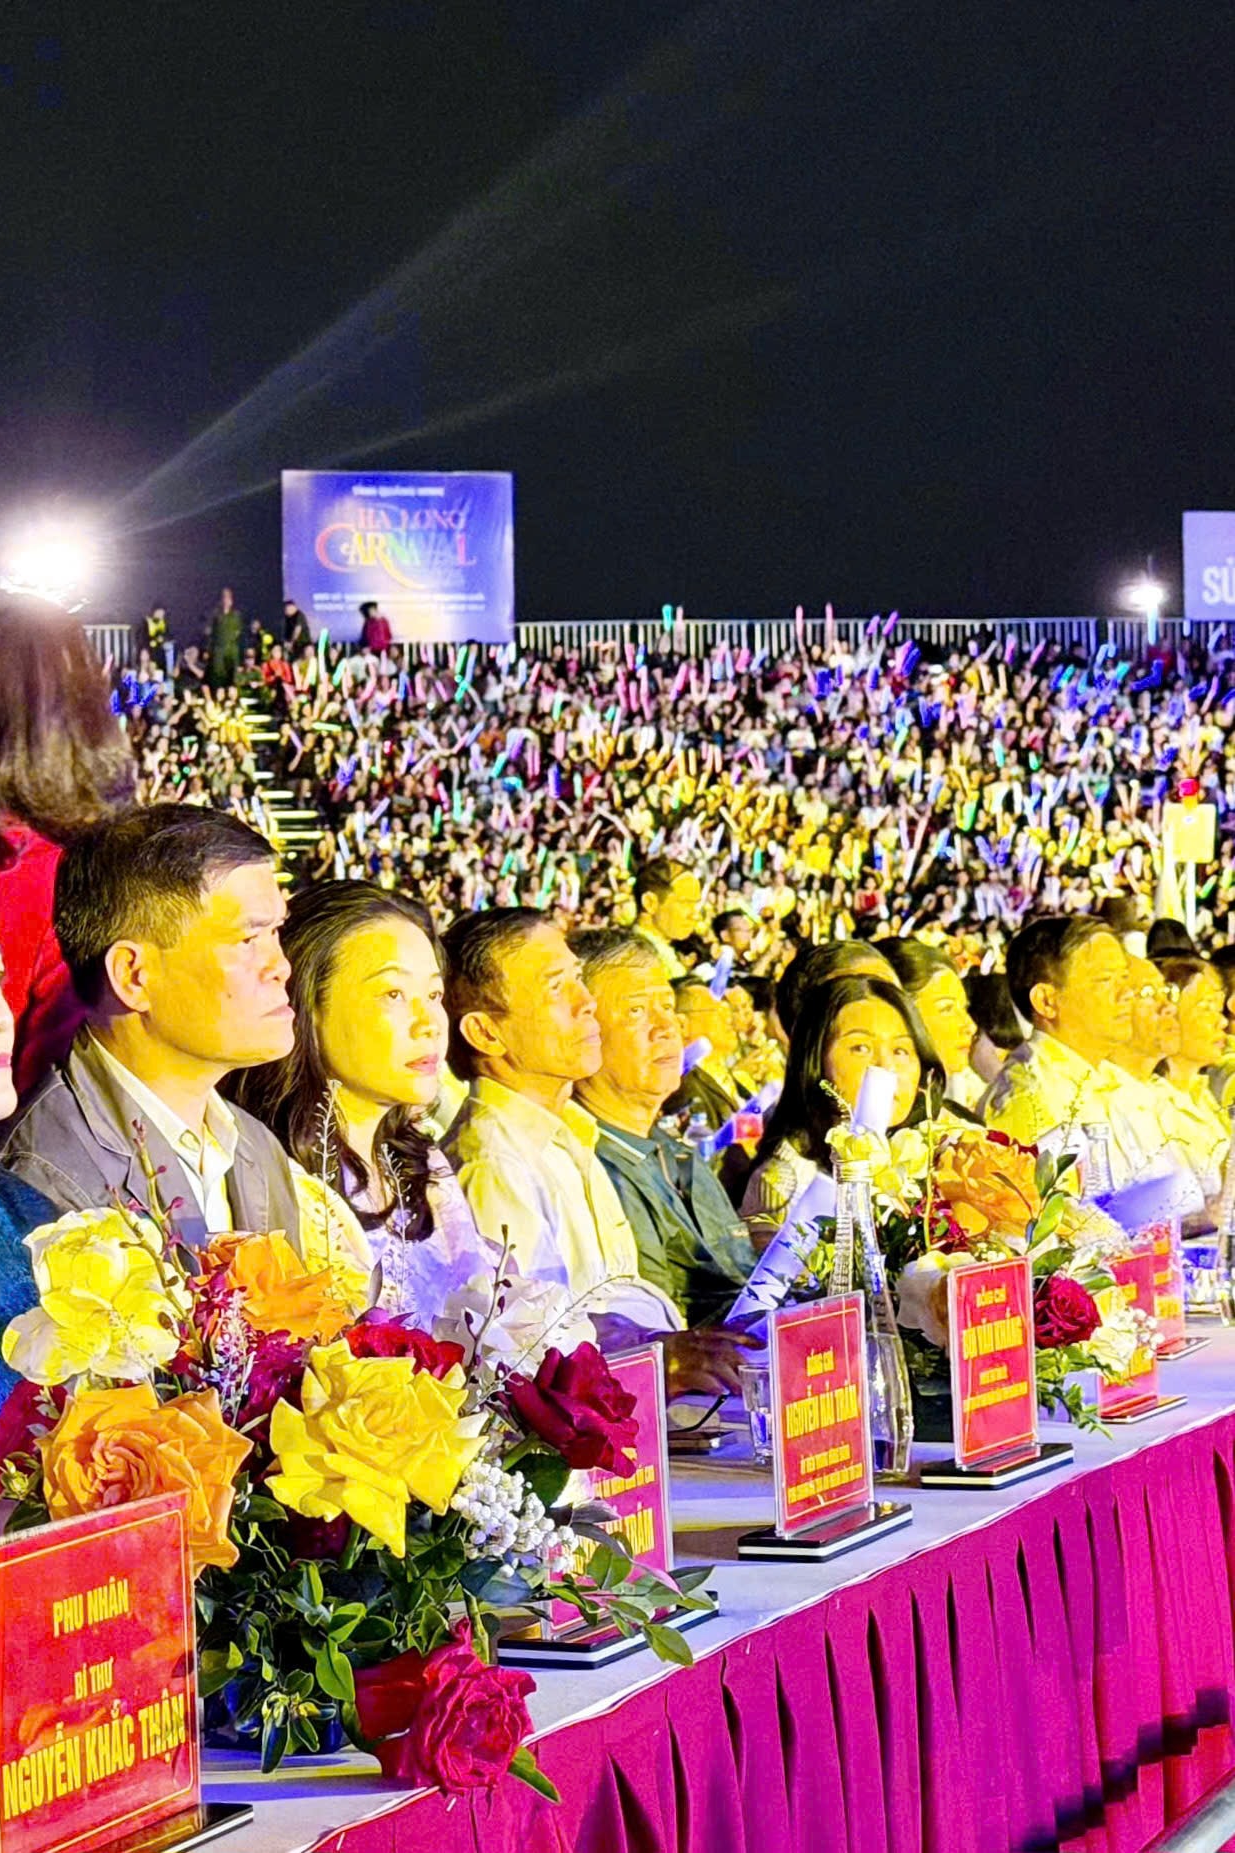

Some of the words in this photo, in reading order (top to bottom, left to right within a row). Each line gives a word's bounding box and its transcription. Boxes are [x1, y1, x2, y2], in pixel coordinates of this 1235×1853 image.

[53, 1595, 84, 1638] PHU
[88, 1576, 129, 1626] NHÂN
[74, 1663, 89, 1700] BÍ
[89, 1656, 114, 1694] THƯ
[2, 1722, 82, 1820] NGUYỄN
[85, 1699, 135, 1784] KHẮC
